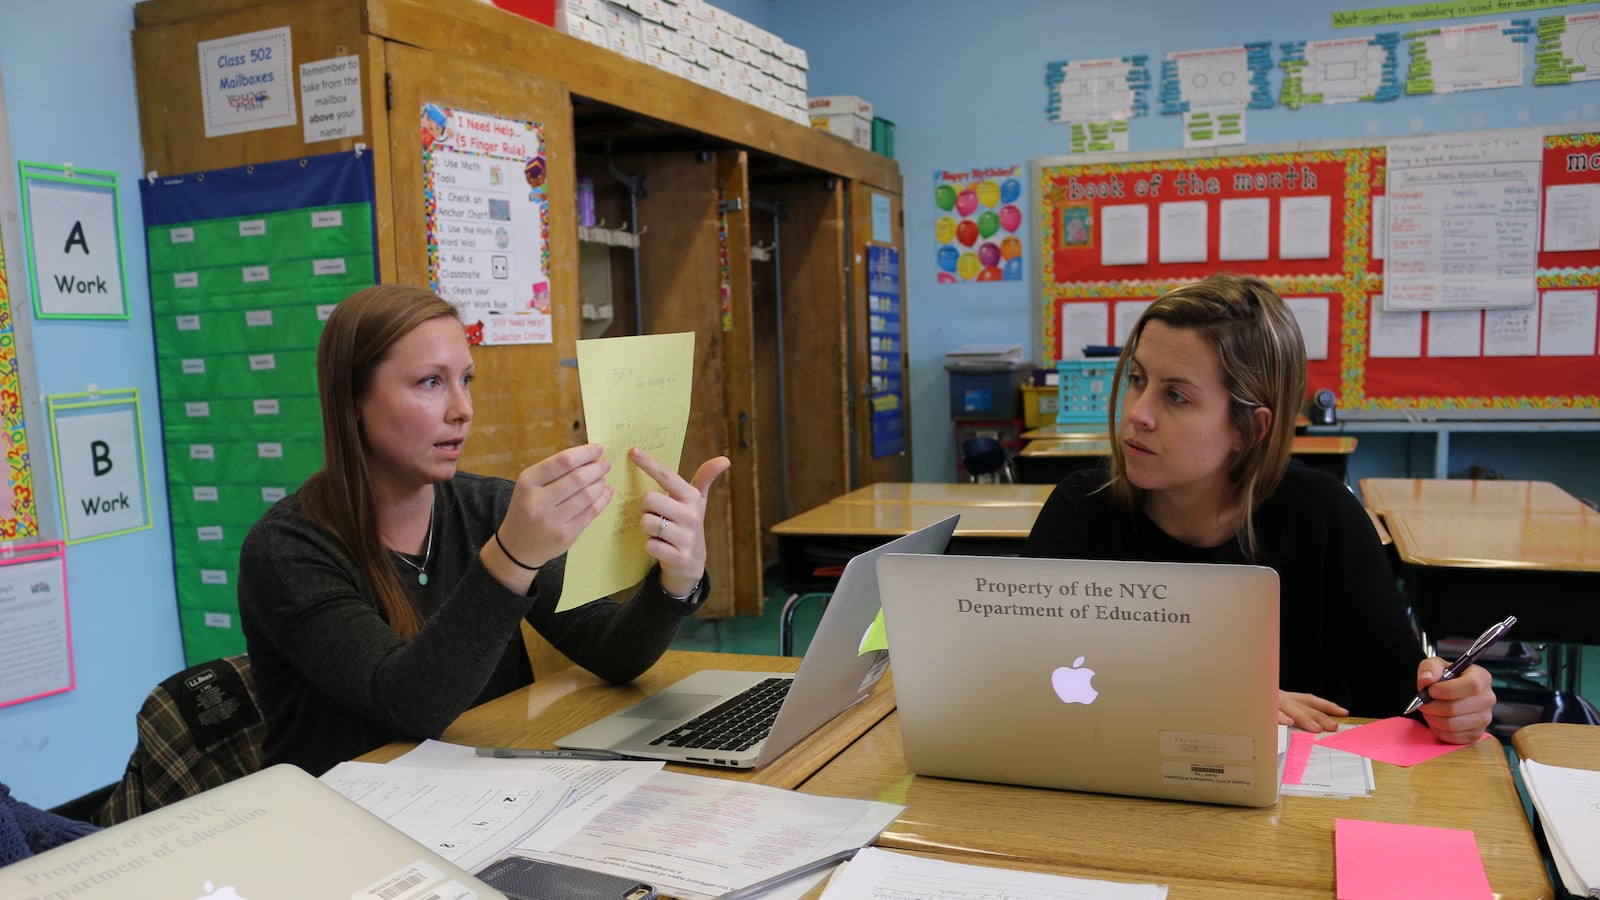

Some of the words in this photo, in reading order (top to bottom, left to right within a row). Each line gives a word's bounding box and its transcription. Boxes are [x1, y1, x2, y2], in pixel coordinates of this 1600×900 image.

[1333, 13, 1360, 25] What
[1362, 11, 1404, 26] cognitive
[1458, 5, 1466, 13] is
[1469, 2, 1492, 12] used
[1499, 0, 1513, 10] for
[217, 54, 246, 69] Class
[250, 47, 272, 62] 502
[302, 62, 346, 77] Remember
[349, 60, 358, 69] to
[218, 71, 275, 91] Mailboxes
[303, 82, 320, 93] take
[321, 79, 342, 89] from
[344, 77, 358, 87] the
[314, 95, 347, 107] mailbox
[309, 111, 335, 124] above
[336, 109, 355, 121] your
[458, 116, 463, 127] I
[467, 118, 490, 132] Need
[320, 125, 346, 137] name!
[470, 138, 499, 155] Finger
[444, 159, 458, 168] Use
[461, 159, 480, 170] Math
[436, 173, 456, 184] Tools
[1069, 176, 1125, 200] book
[1134, 173, 1162, 197] of
[1173, 172, 1220, 195] the
[1233, 166, 1317, 191] month
[447, 192, 471, 203] Check
[438, 206, 464, 218] Anchor
[467, 209, 488, 220] Chart
[64, 219, 90, 255] A
[447, 225, 460, 234] Use
[463, 225, 474, 234] the
[476, 227, 493, 236] Math
[439, 239, 458, 248] Word
[461, 240, 476, 248] Wall
[451, 254, 465, 263] Ask
[441, 269, 480, 280] Classmate
[54, 274, 108, 294] Work
[451, 285, 472, 295] Check
[475, 287, 490, 298] your
[90, 440, 113, 477] B
[81, 491, 130, 517] Work
[974, 577, 1052, 598] Property
[1058, 581, 1079, 596] of
[1084, 582, 1113, 597] the
[1119, 583, 1168, 600] NYC
[956, 598, 1064, 618] Department
[1070, 604, 1090, 619] of
[1095, 605, 1192, 624] Education
[24, 845, 120, 888] Property
[122, 832, 146, 849] of
[147, 819, 179, 840] the
[179, 800, 228, 824] NYC
[25, 856, 151, 900] epartment
[153, 843, 176, 860] of
[175, 806, 268, 848] Education
